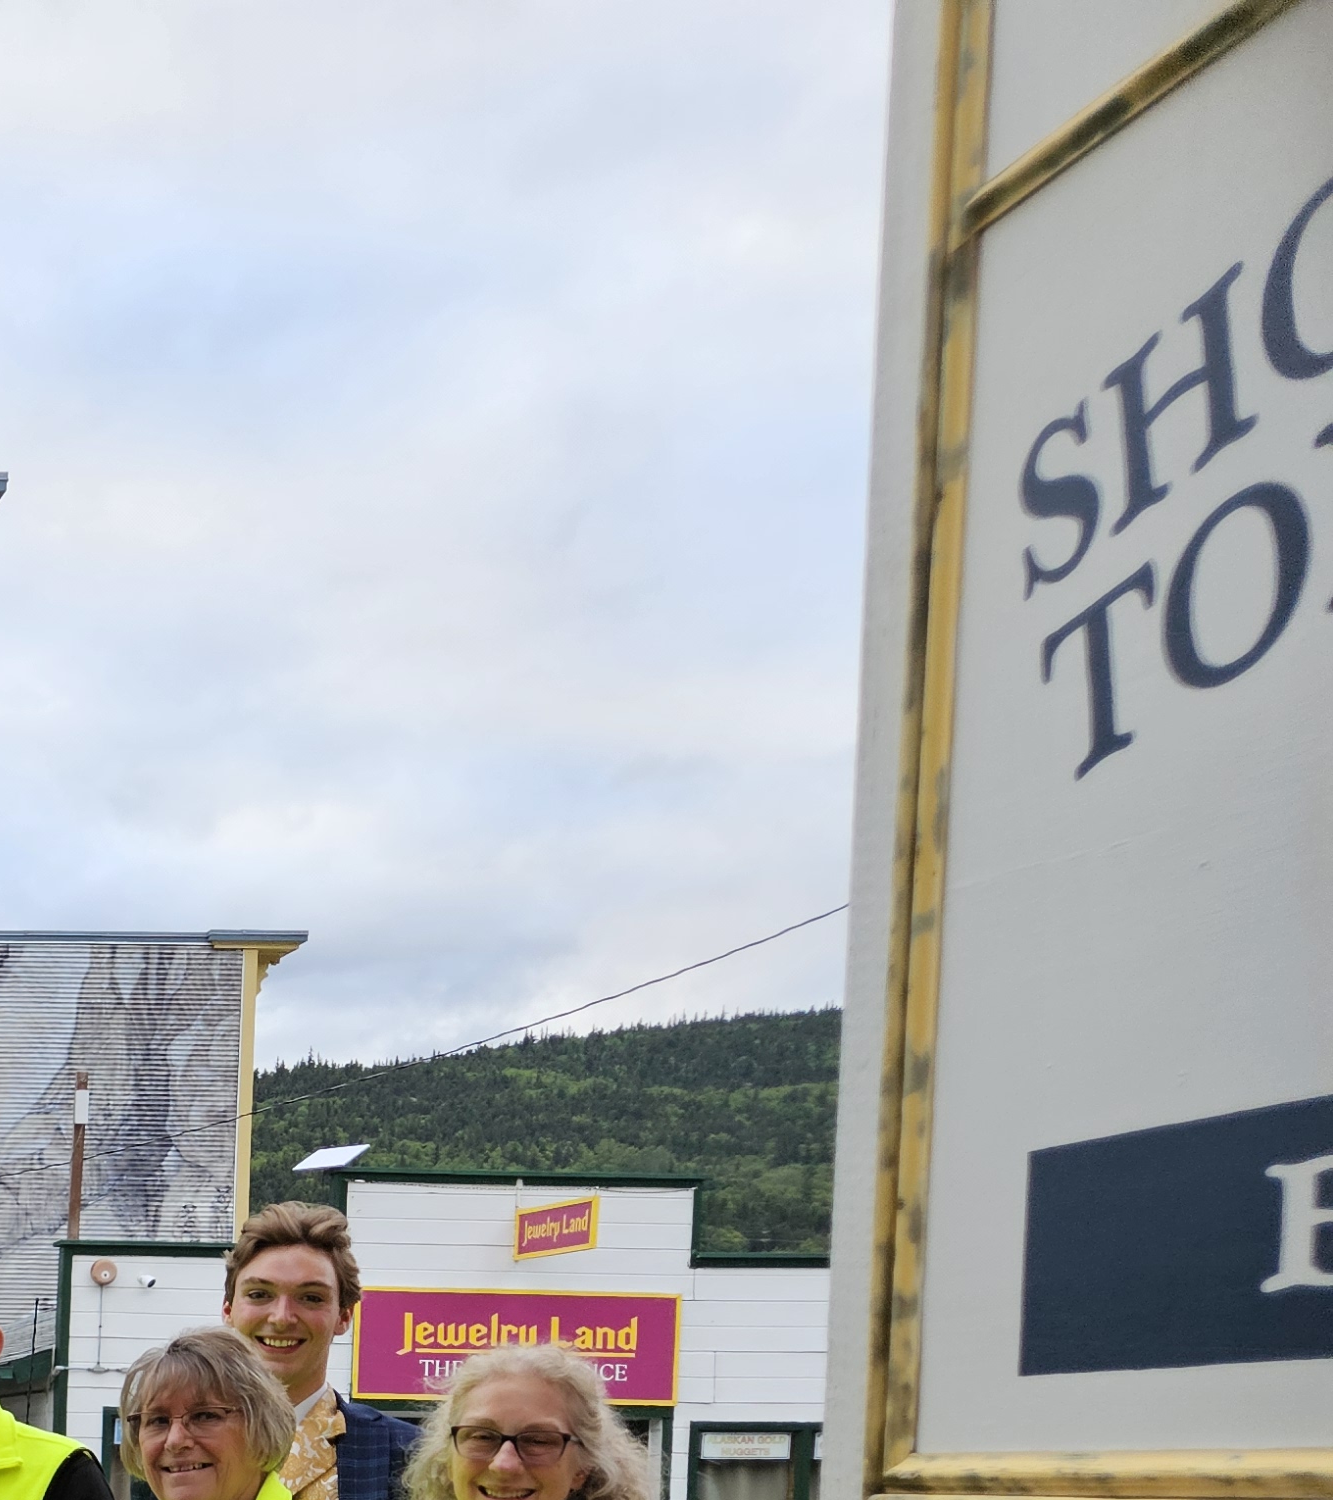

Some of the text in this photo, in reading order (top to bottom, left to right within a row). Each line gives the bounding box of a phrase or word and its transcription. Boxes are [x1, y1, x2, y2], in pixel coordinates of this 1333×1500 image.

[1040, 424, 1333, 781] TO
[522, 1208, 590, 1247] Jewelry Land
[396, 1312, 638, 1355] Jewelry Land
